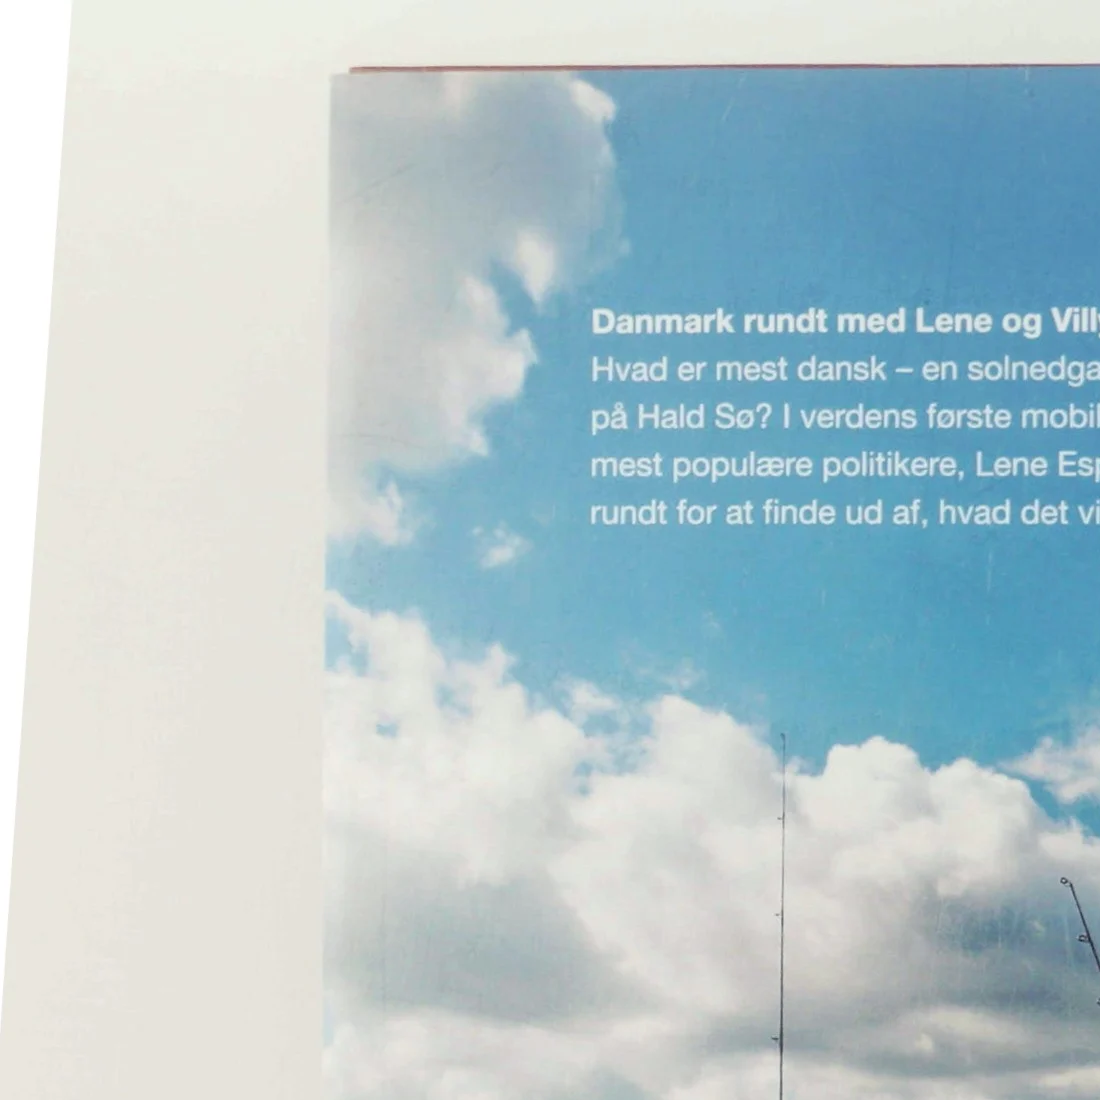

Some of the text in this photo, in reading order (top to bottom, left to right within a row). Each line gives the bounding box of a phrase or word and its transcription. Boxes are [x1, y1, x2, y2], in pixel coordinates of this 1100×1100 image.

[591, 307, 735, 335] Danmark
[743, 307, 829, 334] rundt
[836, 306, 907, 334] med
[915, 306, 994, 334] Lene
[1001, 312, 1043, 340] og
[591, 355, 668, 382] Hvad
[677, 361, 707, 382] er
[716, 356, 788, 382] mest
[797, 355, 887, 382] dansk
[921, 360, 958, 381] en
[591, 402, 628, 436] på
[638, 403, 705, 429] Hald
[715, 402, 773, 430] Sø?
[783, 402, 790, 429] I
[800, 403, 918, 429] verdens
[925, 402, 1013, 429] første
[591, 452, 663, 477] mest
[672, 450, 814, 483] populære
[822, 450, 965, 483] politikere,
[975, 451, 1049, 477] Lene
[590, 499, 668, 526] rundt
[675, 498, 718, 525] for
[725, 500, 754, 525] at
[762, 498, 837, 526] finde
[845, 499, 883, 526] ud
[892, 498, 928, 529] af,
[939, 498, 1012, 526] hvad
[1020, 498, 1069, 526] det
